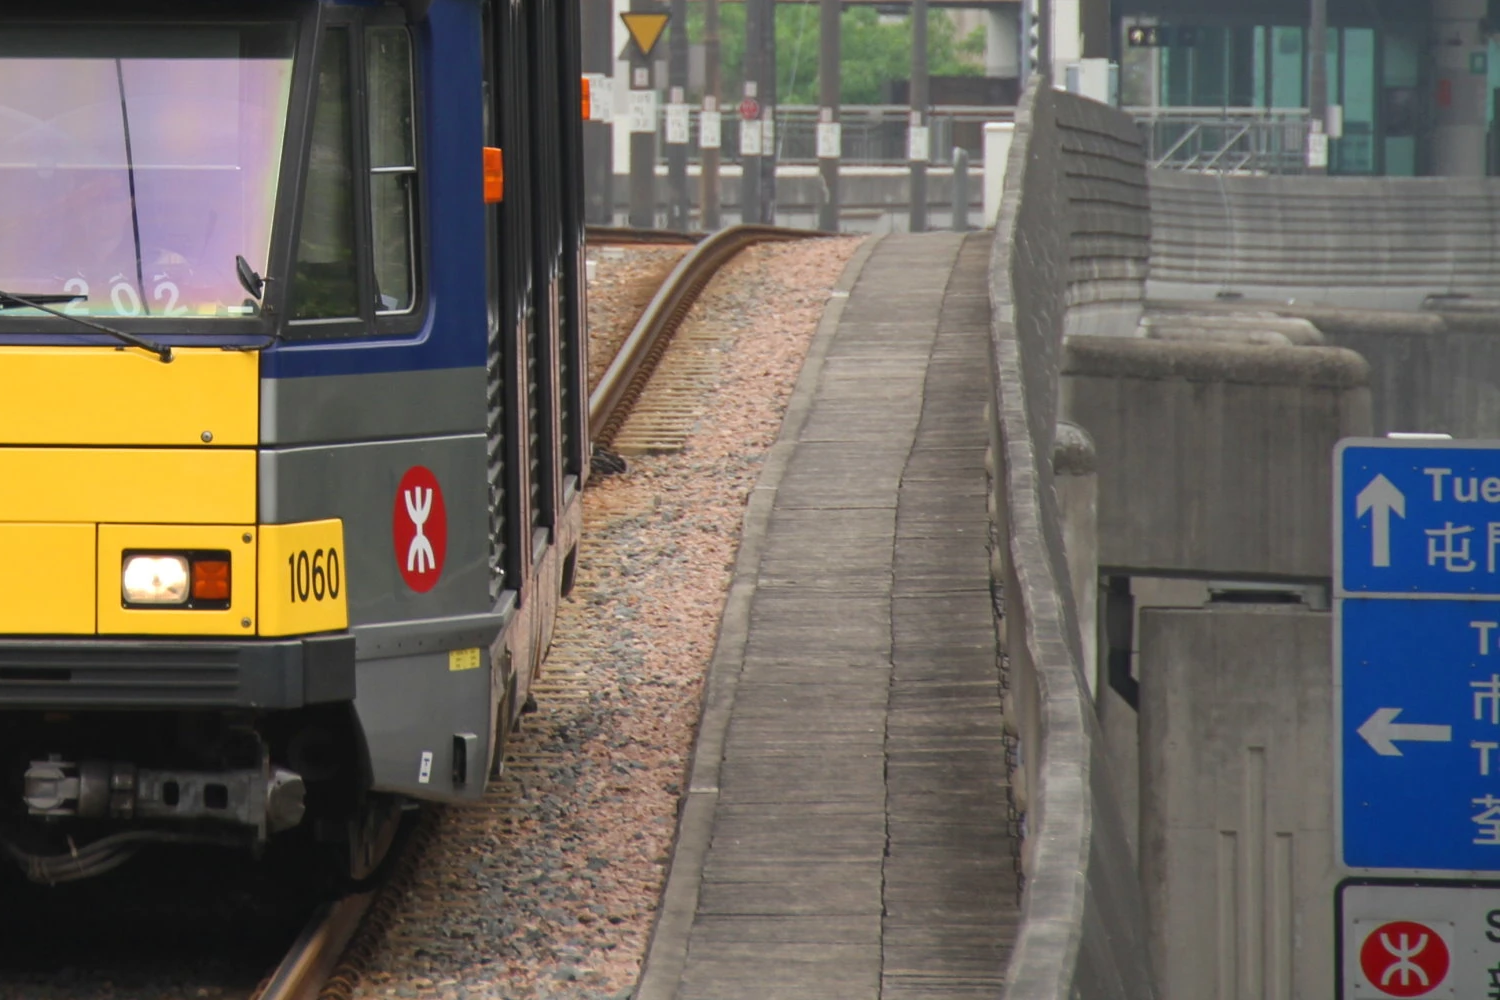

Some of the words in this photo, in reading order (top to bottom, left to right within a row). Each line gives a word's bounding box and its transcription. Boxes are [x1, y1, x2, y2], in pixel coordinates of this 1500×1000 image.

[63, 278, 188, 317] 202
[1424, 521, 1500, 573] 屯
[288, 547, 340, 603] 1060
